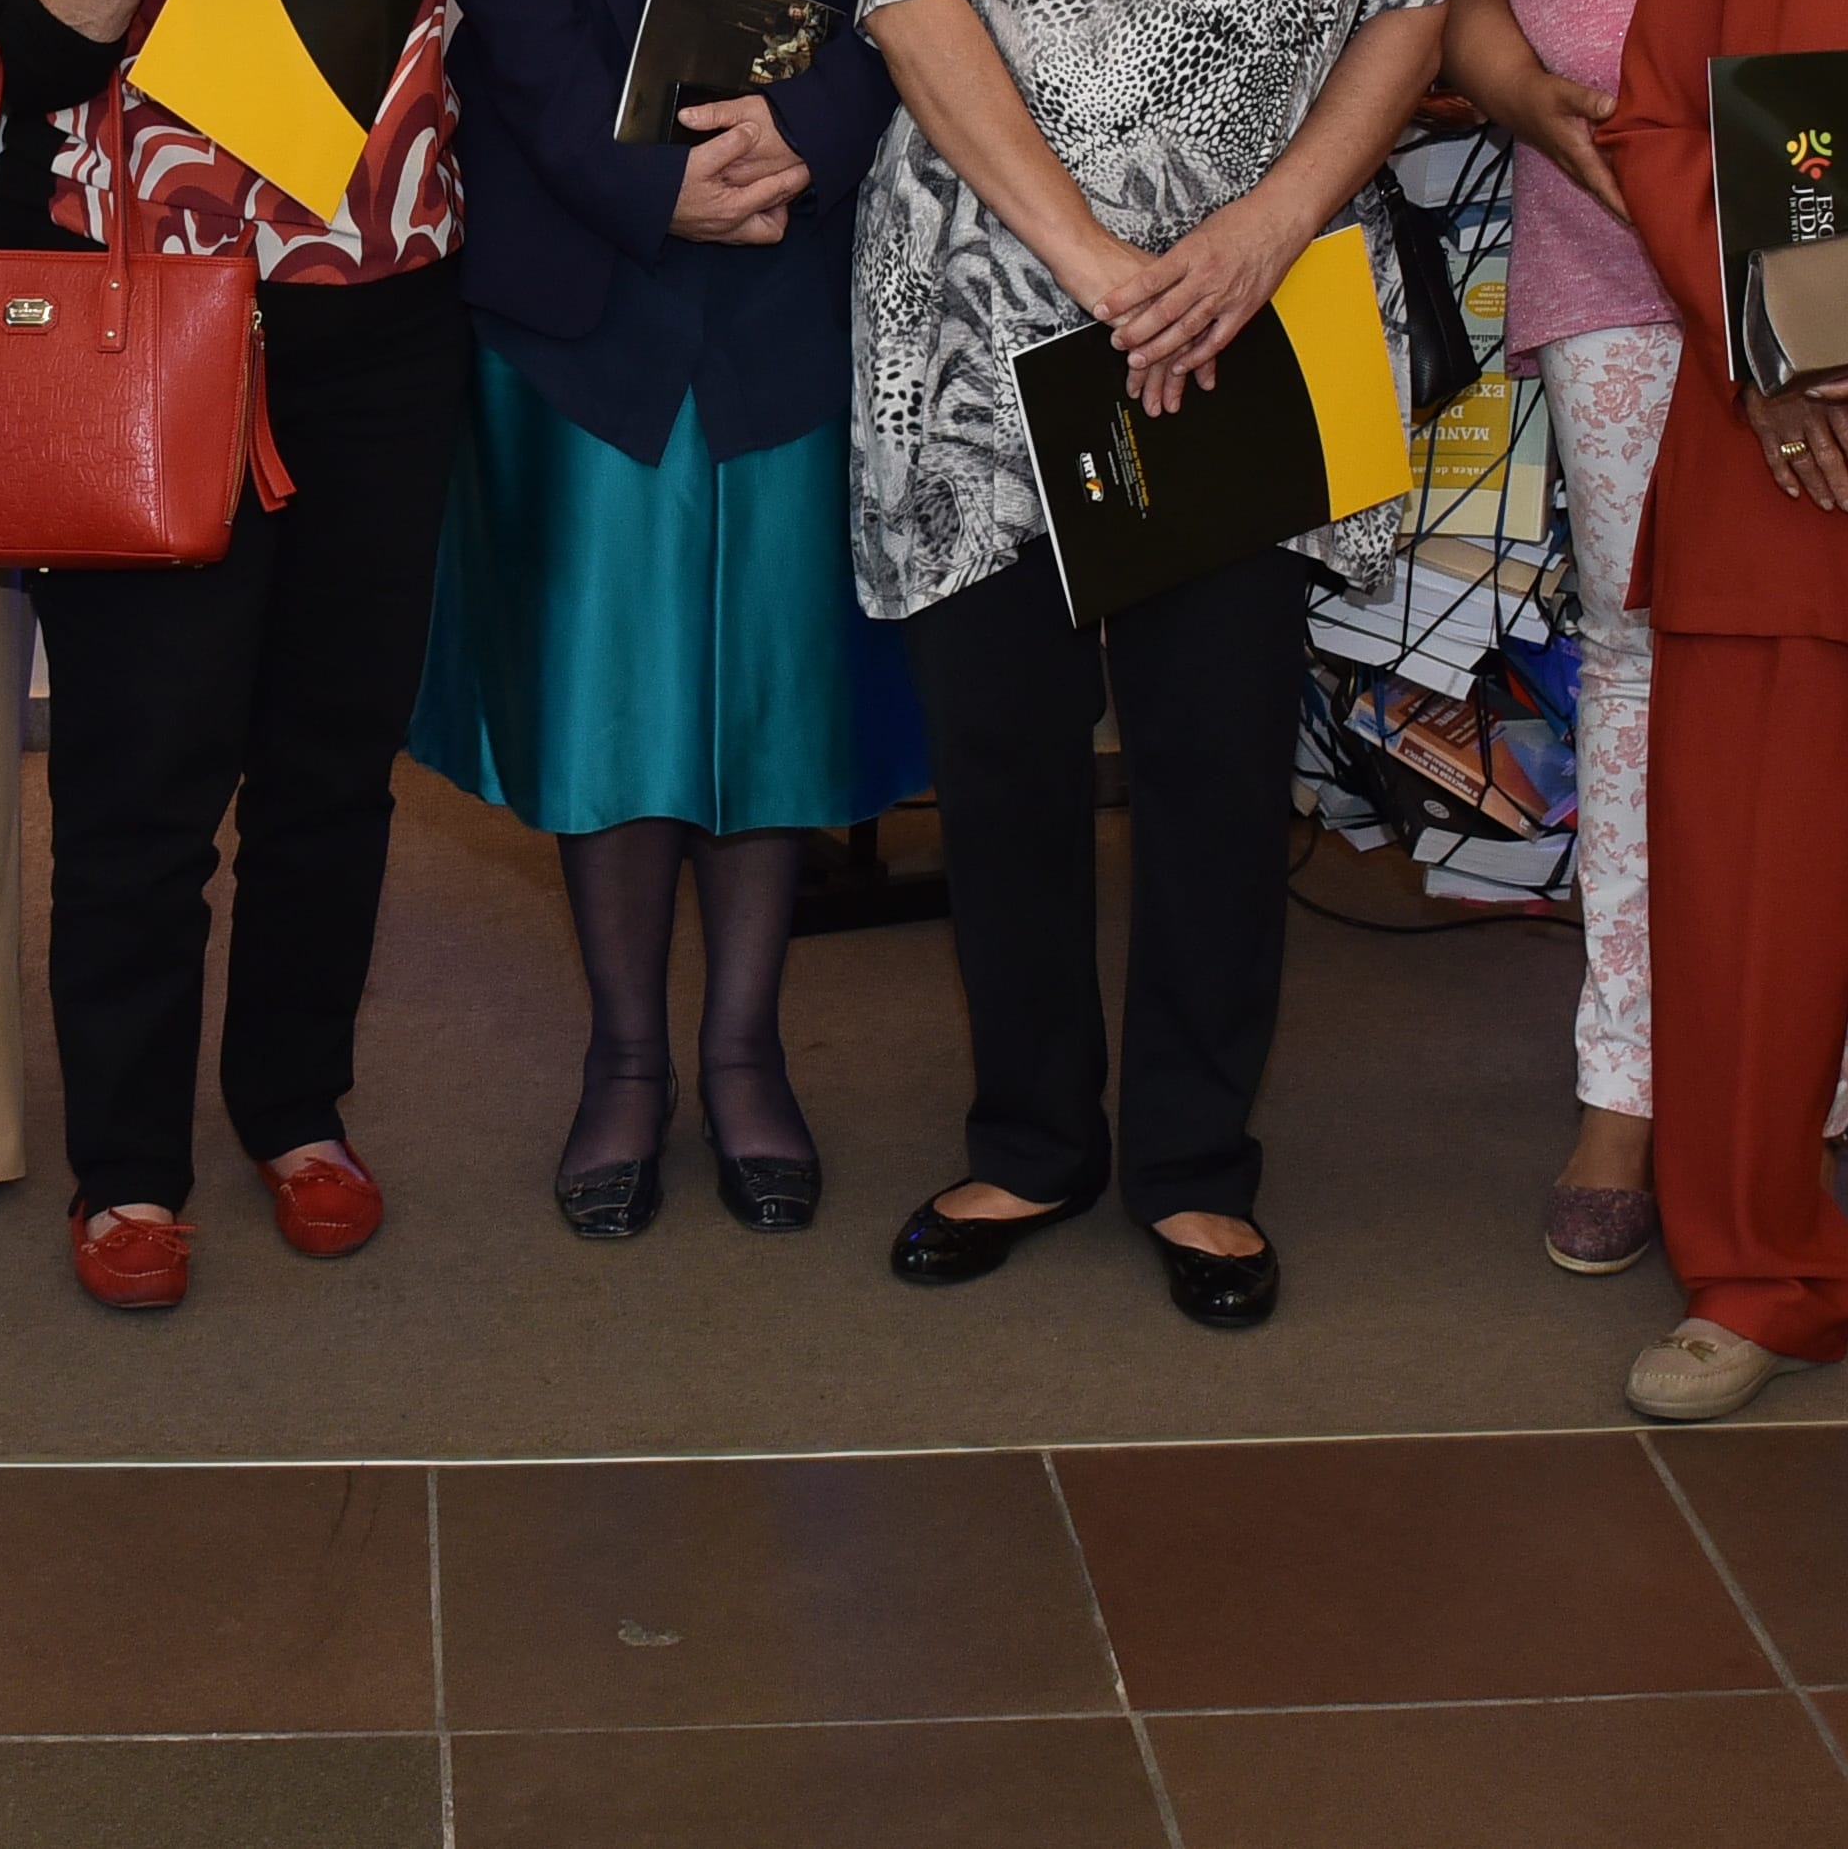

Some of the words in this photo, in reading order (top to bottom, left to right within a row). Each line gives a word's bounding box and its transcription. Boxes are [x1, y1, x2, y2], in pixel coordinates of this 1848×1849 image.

[1792, 184, 1817, 240] JUDI
[1816, 194, 1835, 239] ESC
[1080, 452, 1097, 478] TRT
[1453, 465, 1488, 476] raken
